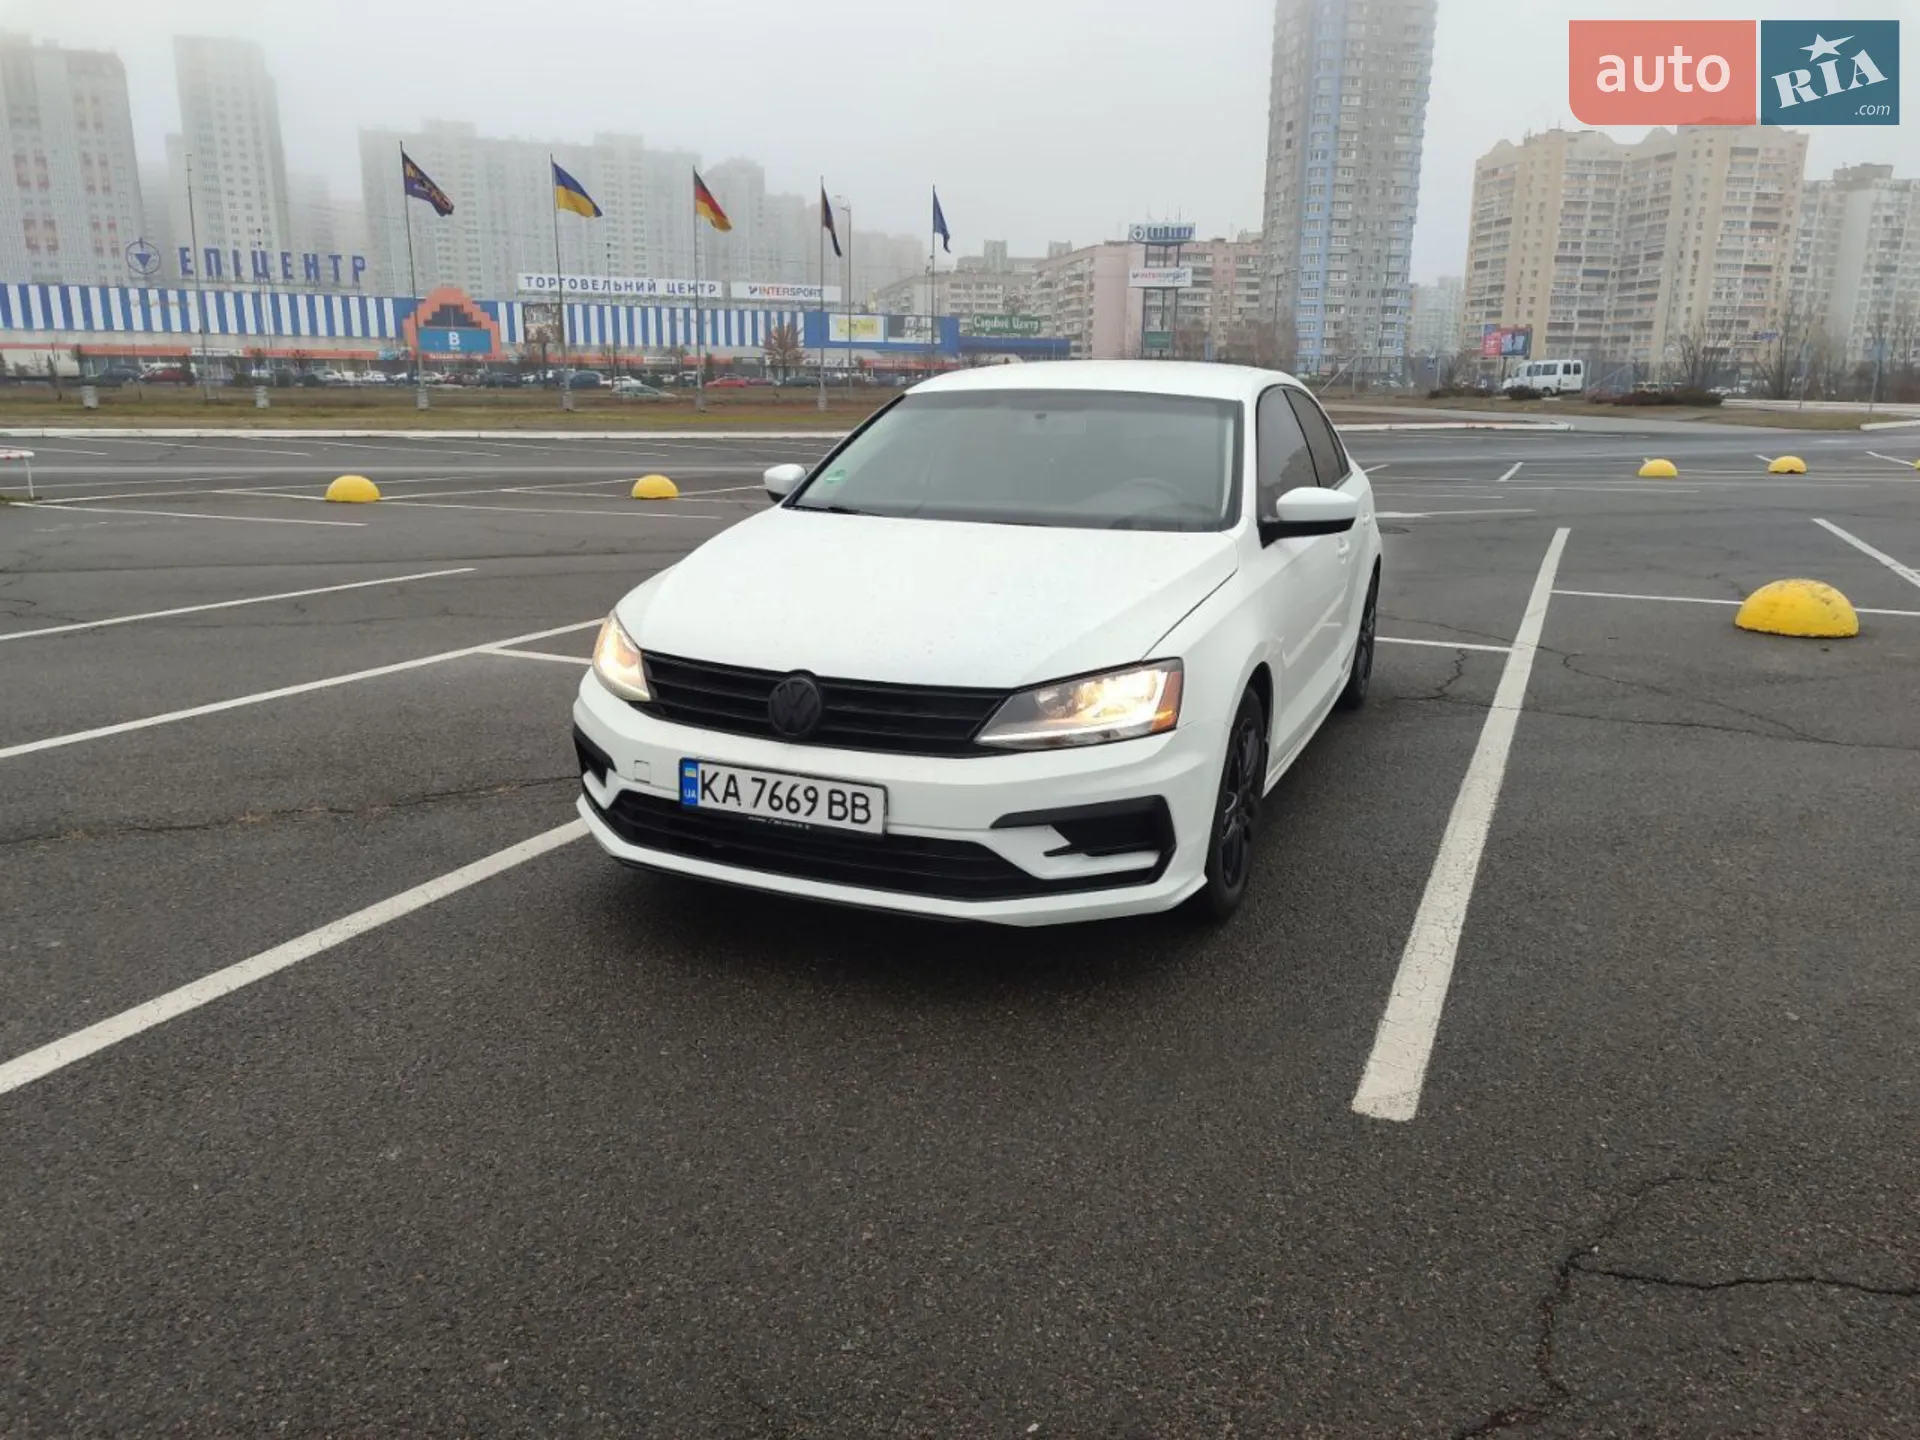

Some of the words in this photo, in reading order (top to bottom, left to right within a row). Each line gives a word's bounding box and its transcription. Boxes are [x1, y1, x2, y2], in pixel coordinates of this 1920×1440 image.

[179, 247, 366, 282] ЕПІЦЕНТР
[525, 276, 656, 293] ТОРГОВЕЛЬНИЙ
[666, 282, 718, 295] ЦЕНТР
[759, 285, 823, 298] INTERSPORT
[684, 788, 697, 799] UA
[700, 769, 741, 805] KA
[751, 777, 819, 816] 7669
[827, 788, 872, 825] BB
